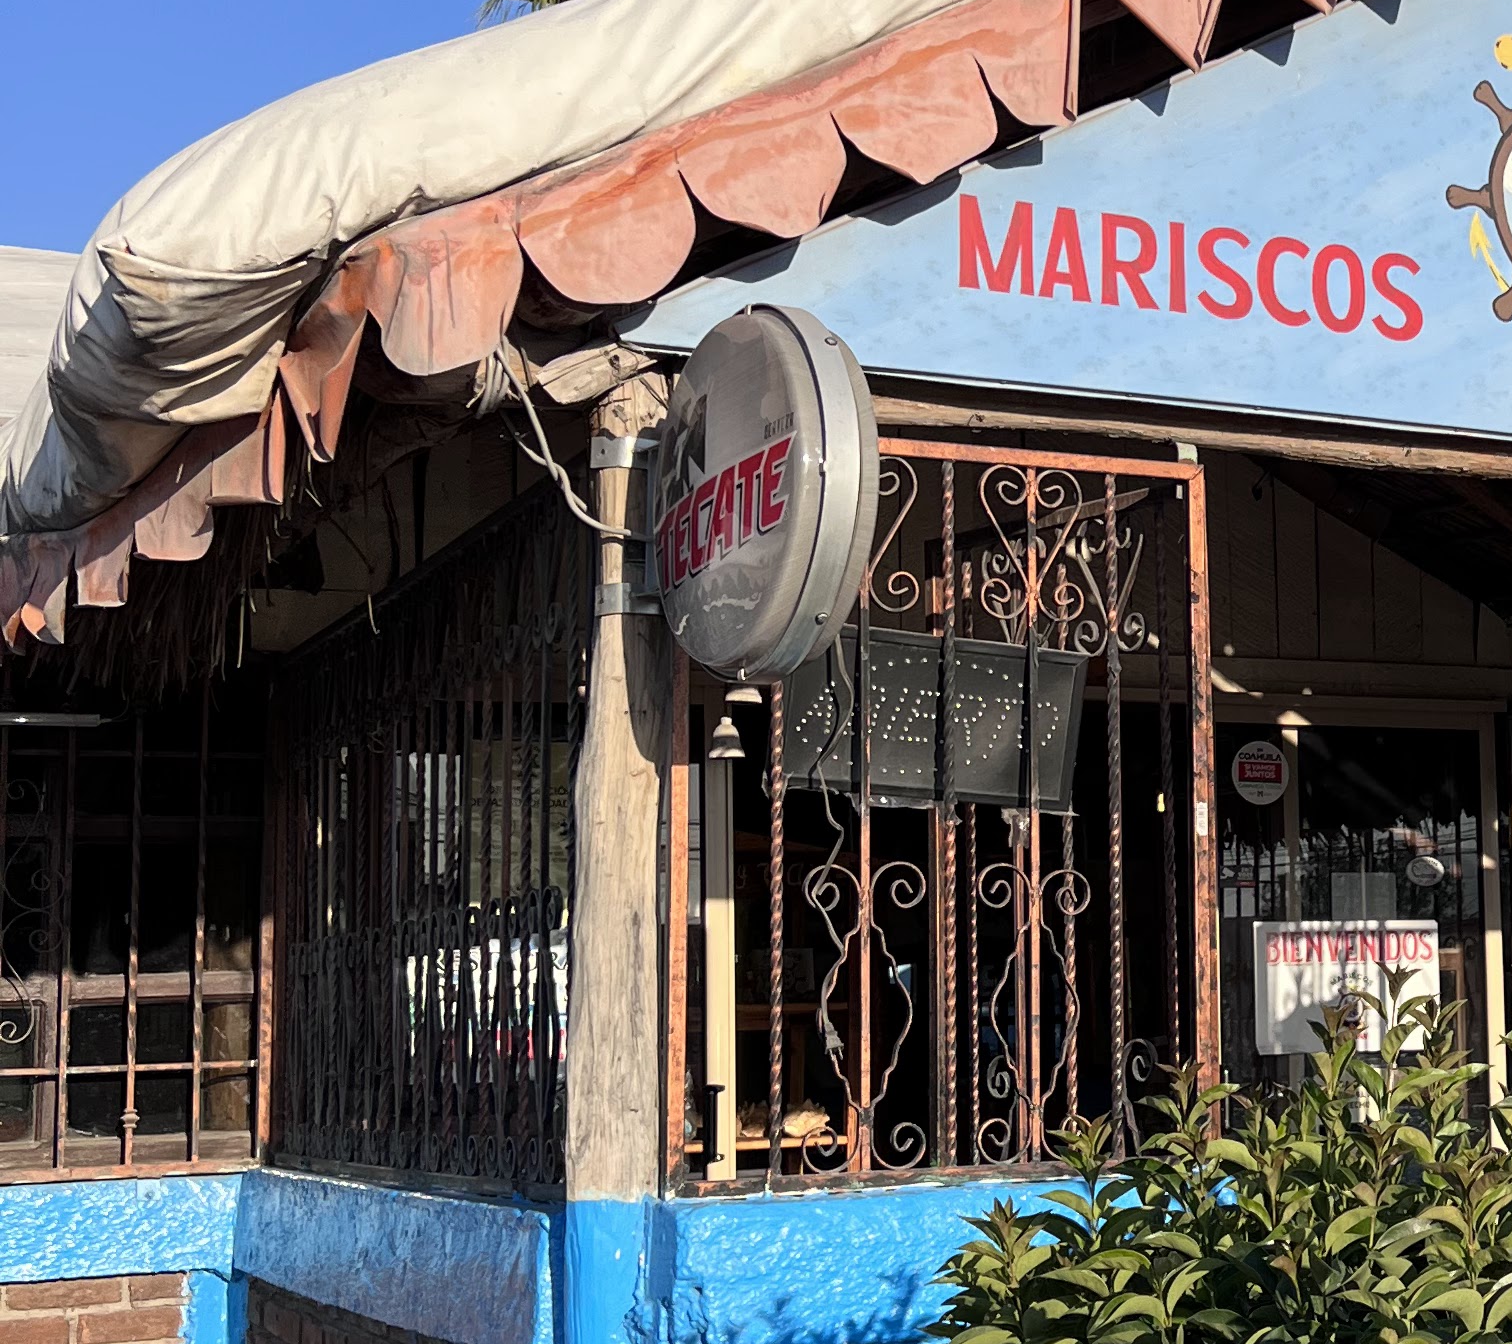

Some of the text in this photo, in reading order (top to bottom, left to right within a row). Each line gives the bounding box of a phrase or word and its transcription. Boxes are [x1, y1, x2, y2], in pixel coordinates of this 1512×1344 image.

[957, 193, 1424, 342] MARISCOS
[656, 432, 797, 598] TECATE
[1266, 929, 1433, 965] BIENVENIDOS
